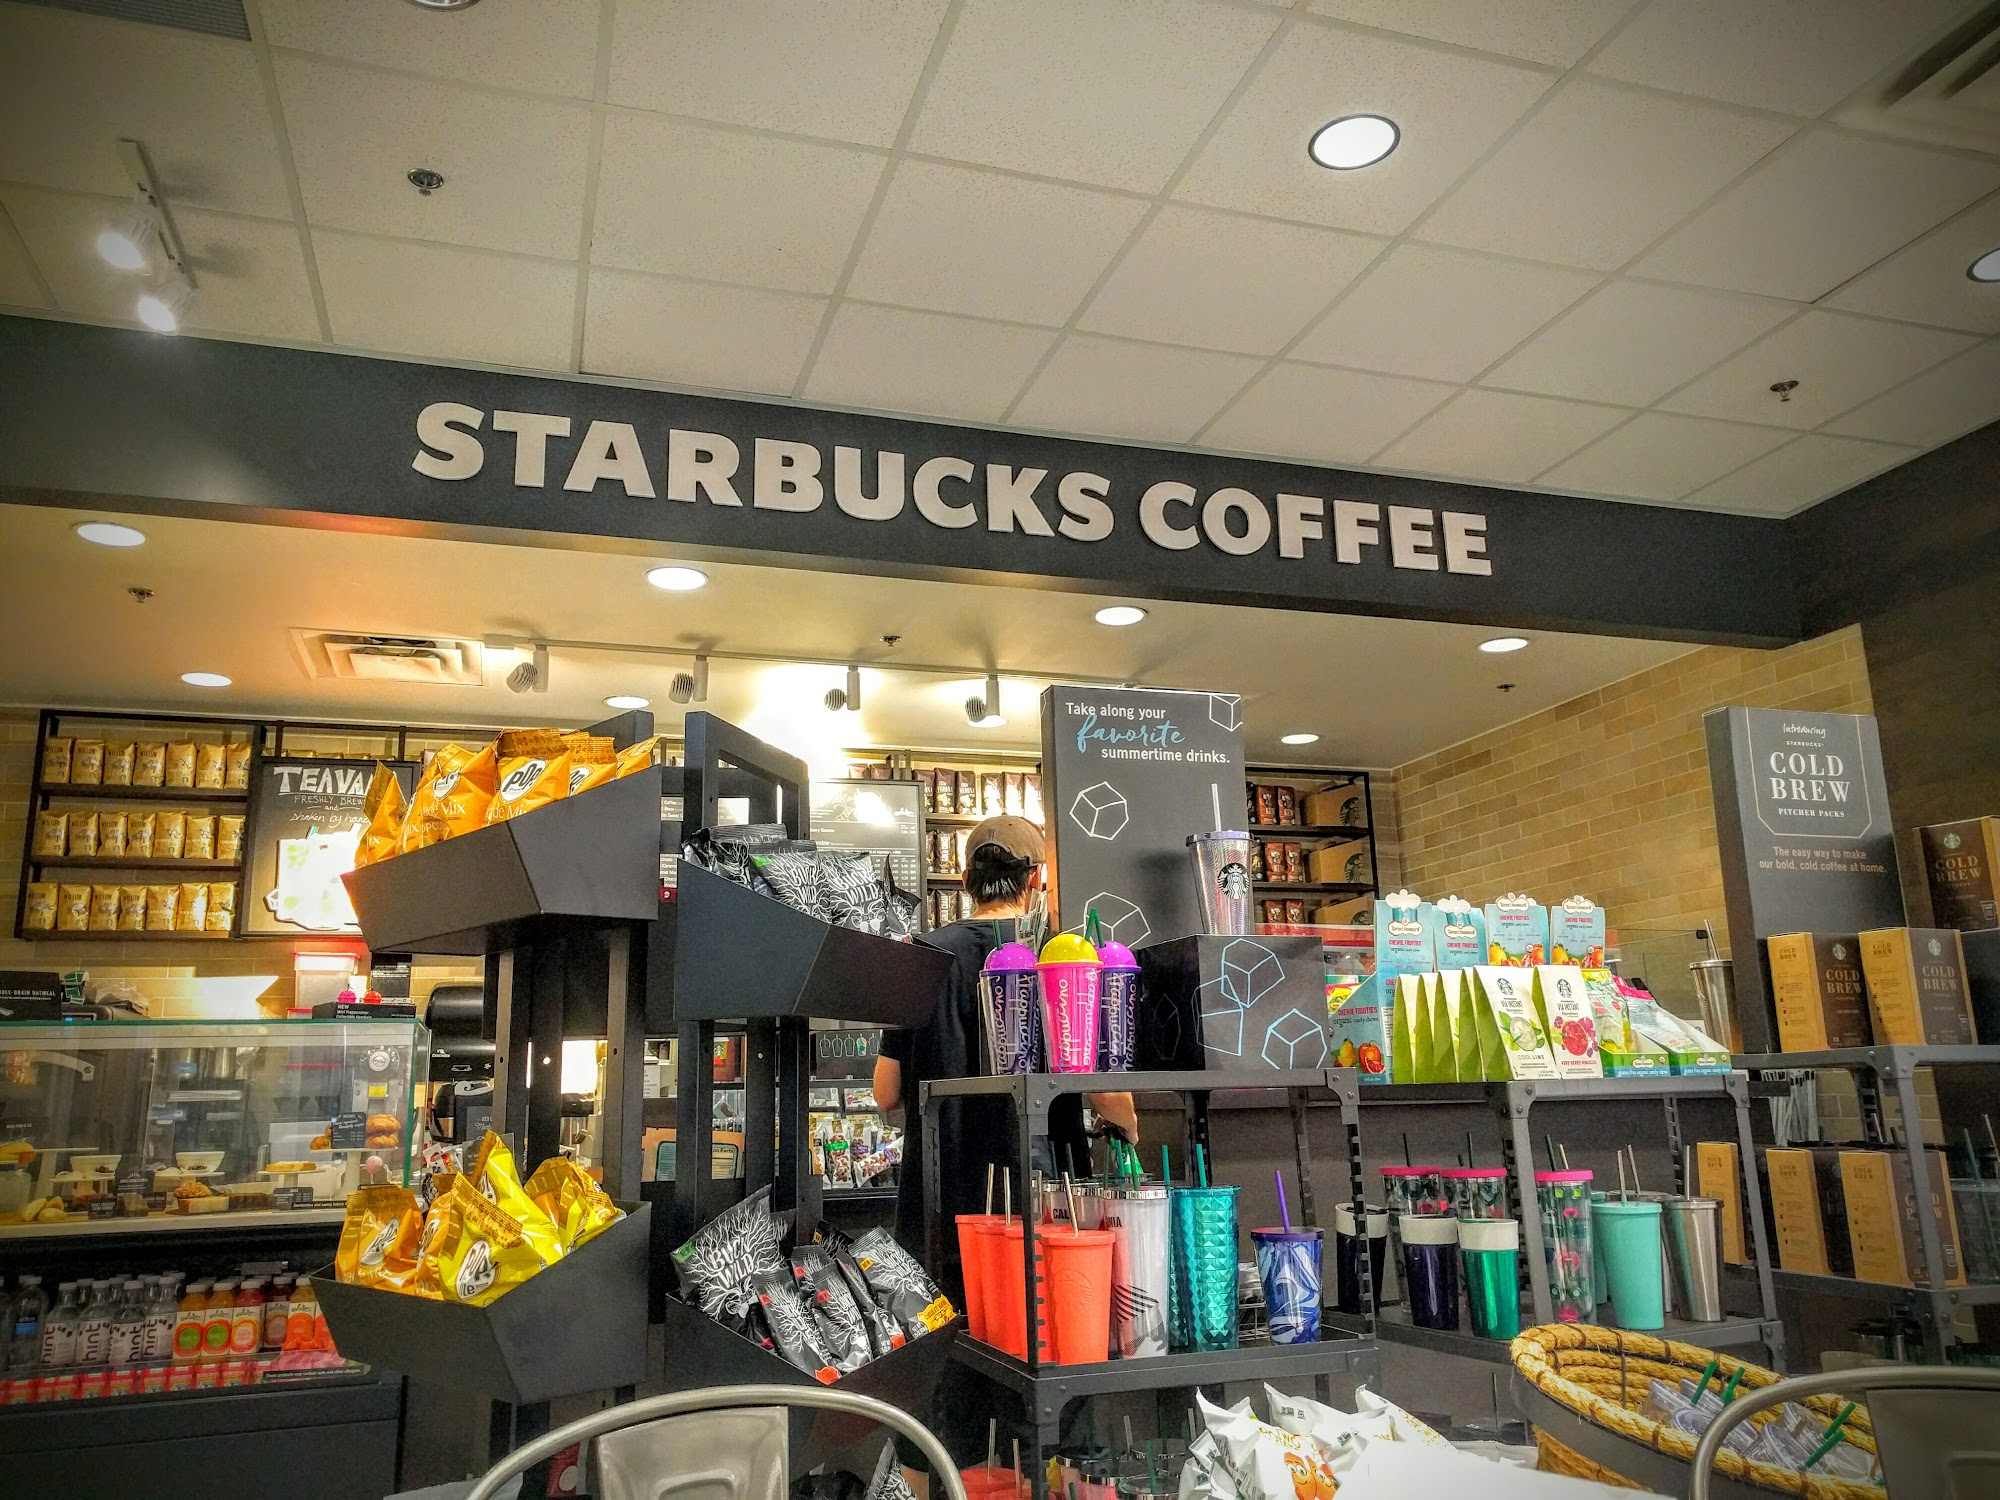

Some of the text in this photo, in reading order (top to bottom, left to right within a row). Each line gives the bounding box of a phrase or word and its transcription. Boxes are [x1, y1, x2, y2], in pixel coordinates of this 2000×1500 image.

[411, 401, 1493, 577] STARBUCKS COFFEE
[1065, 702, 1167, 720] Take along your
[1077, 715, 1186, 753] favorite
[1783, 723, 1826, 738] Introducing
[1101, 748, 1230, 763] summertime drinks.
[1770, 752, 1844, 777] COLD
[273, 766, 374, 796] TEAVA
[1769, 778, 1850, 803] BREW
[294, 795, 366, 805] FRESHLY BREW
[329, 813, 343, 828] by
[1778, 808, 1845, 818] PITCHER PACKS
[1773, 847, 1867, 859] The easy way to make
[1775, 860, 1797, 870] bold,
[1800, 861, 1817, 870] cold
[1821, 861, 1847, 871] coffee
[1850, 862, 1858, 871] at
[1860, 862, 1887, 873] home.
[835, 869, 873, 891] BUCK
[847, 883, 880, 905] WILD
[1826, 969, 1860, 981] COLD
[1922, 965, 1955, 977] COLD
[1827, 982, 1863, 994] BREW
[1923, 978, 1957, 990] BREW
[1905, 1193, 1939, 1207] CD
[720, 1253, 754, 1289] WILD
[42, 1323, 55, 1363] hint
[82, 1322, 101, 1361] hint
[126, 1324, 144, 1362] hint
[143, 1318, 158, 1356] hint
